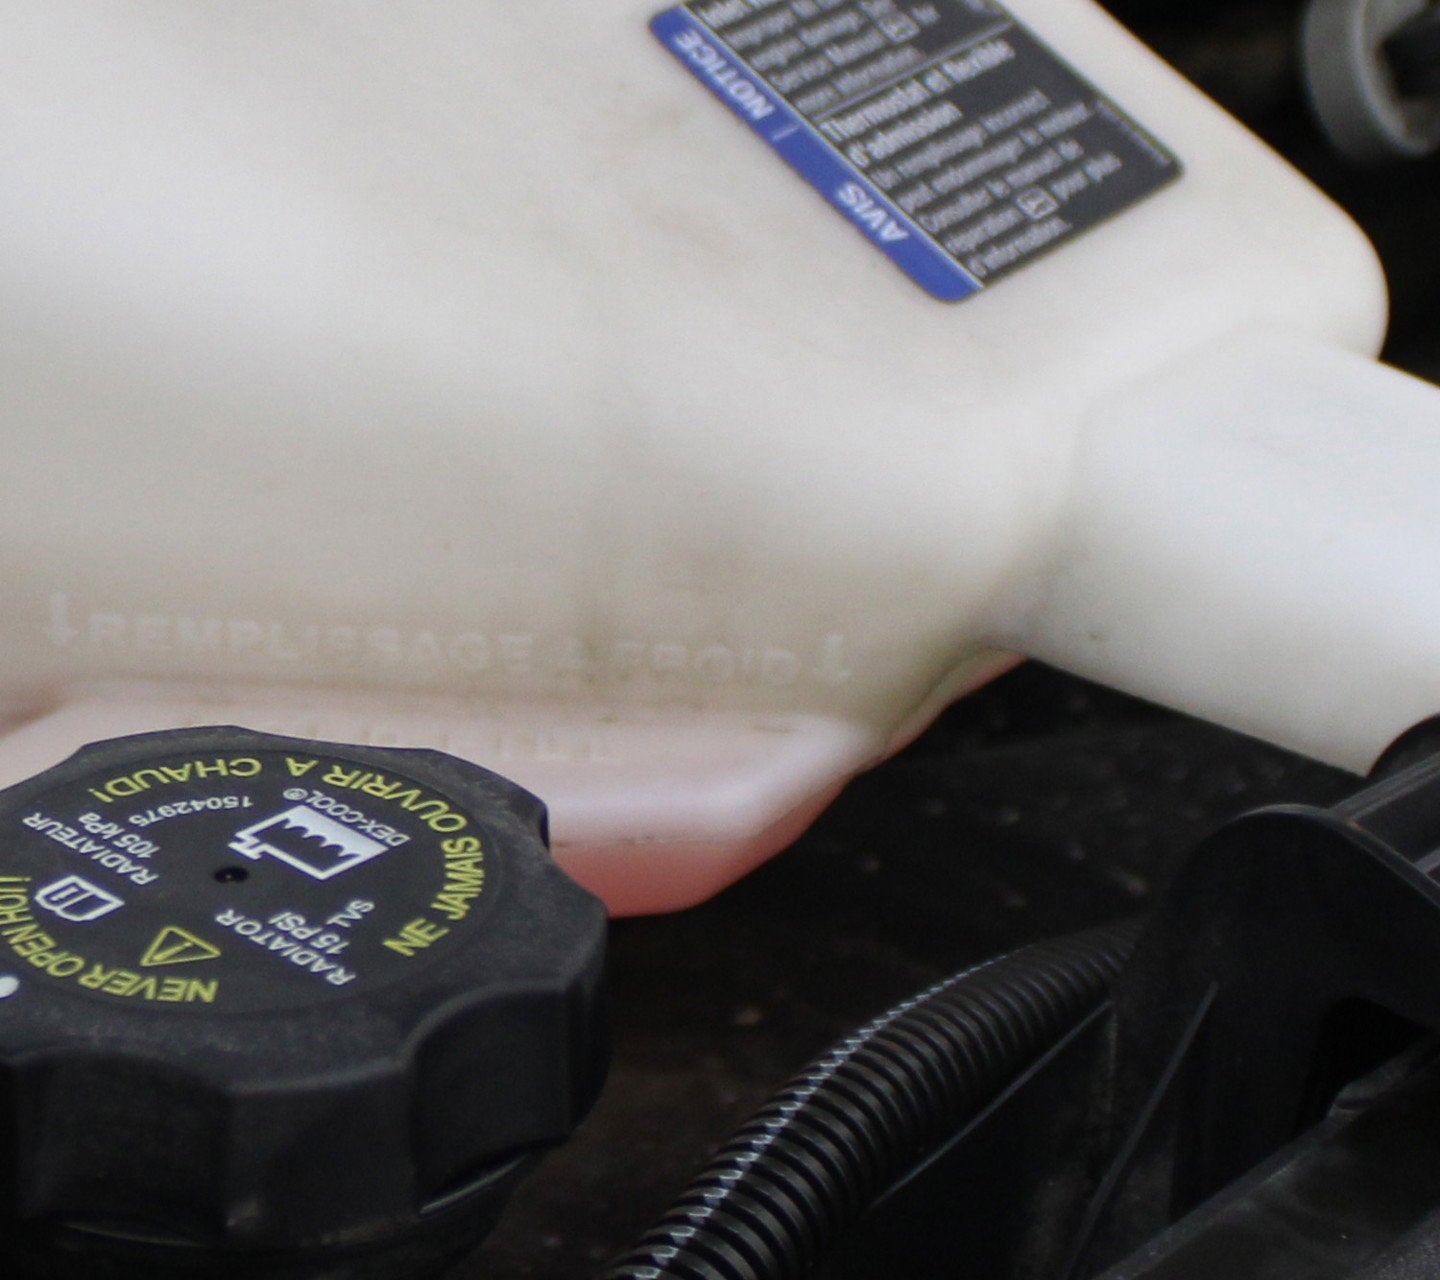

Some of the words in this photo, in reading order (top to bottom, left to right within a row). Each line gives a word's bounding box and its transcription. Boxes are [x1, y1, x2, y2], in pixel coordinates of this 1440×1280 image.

[673, 31, 777, 120] NOTICE
[834, 182, 911, 244] AVIS
[89, 756, 264, 803] CHAUD!
[286, 756, 320, 777] A
[128, 795, 253, 827] 15042975
[322, 764, 469, 834] OUVRIR
[22, 812, 159, 885] RADIATEUR
[77, 812, 128, 848] kPa
[117, 833, 160, 858] 105
[431, 835, 485, 920] JAMAIS
[215, 908, 355, 986] RADIATOR
[268, 911, 323, 940] PSI
[312, 933, 349, 954] 15
[383, 917, 447, 955] NE
[1, 923, 86, 977] OPEN
[78, 963, 220, 1004] NEVER
